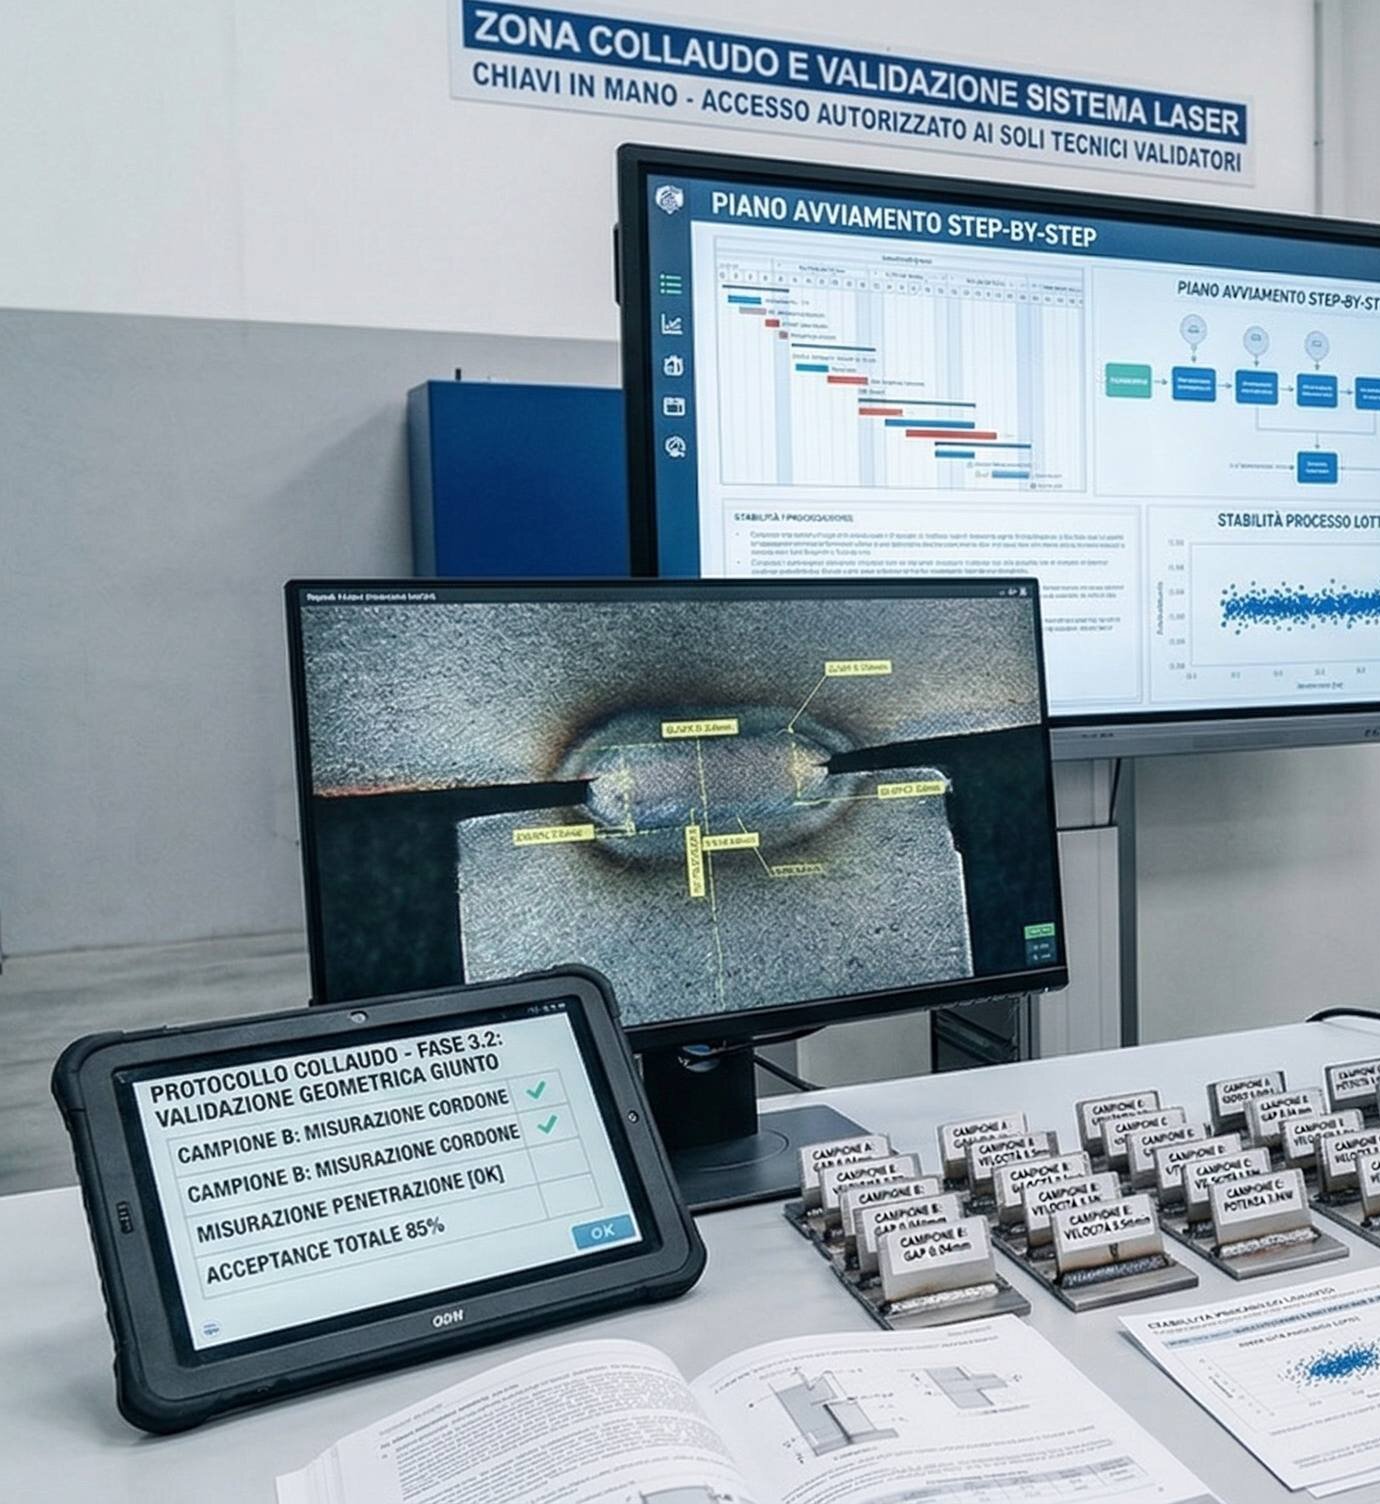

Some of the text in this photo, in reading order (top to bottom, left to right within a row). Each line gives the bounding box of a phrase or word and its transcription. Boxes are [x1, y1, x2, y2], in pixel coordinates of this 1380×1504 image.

[474, 10, 1241, 136] ZONA COLLAUDO E VALIDAZIONE SISTEMA LASER
[473, 61, 562, 95] CHIAVI
[569, 72, 595, 97] IN
[604, 77, 678, 108] MANO
[702, 89, 810, 122] ACCESSO
[816, 101, 967, 142] AUTORIZZATO
[973, 120, 993, 143] AI
[1000, 124, 1045, 150] SOLI
[1051, 130, 1128, 160] TECNICI
[1133, 140, 1242, 173] VALIDATORI
[711, 191, 1097, 249] PIANO AVVIAMENTO STEP-BY-STEP
[1177, 280, 1220, 298] PIANO
[1222, 285, 1306, 305] AVVIAMENTO
[1217, 511, 1283, 528] STABILITÀ
[1286, 513, 1352, 529] PROCESSO
[150, 1064, 288, 1104] PROTOCOLLO
[294, 1046, 399, 1080] COLLAUDO
[417, 1036, 464, 1059] FASE
[469, 1030, 503, 1050] 3.2:
[155, 1053, 500, 1128] VALIDAZIONE GEOMETRICA GIUNTO
[177, 1088, 510, 1164] CAMPIONE B: MISURAZIONE CORDONE
[188, 1123, 522, 1204] CAMPIONE B: MISURAZIONE CORDONE
[196, 1164, 506, 1243] MISURAZIONE PENETRAZIONE [OK]
[591, 1223, 616, 1240] OK
[1069, 1206, 1120, 1226] CAMPIONE
[206, 1216, 445, 1285] ACCEPTANCE TOTALE 85%
[900, 1229, 955, 1249] CAMPIONE
[903, 1247, 926, 1262] GAP
